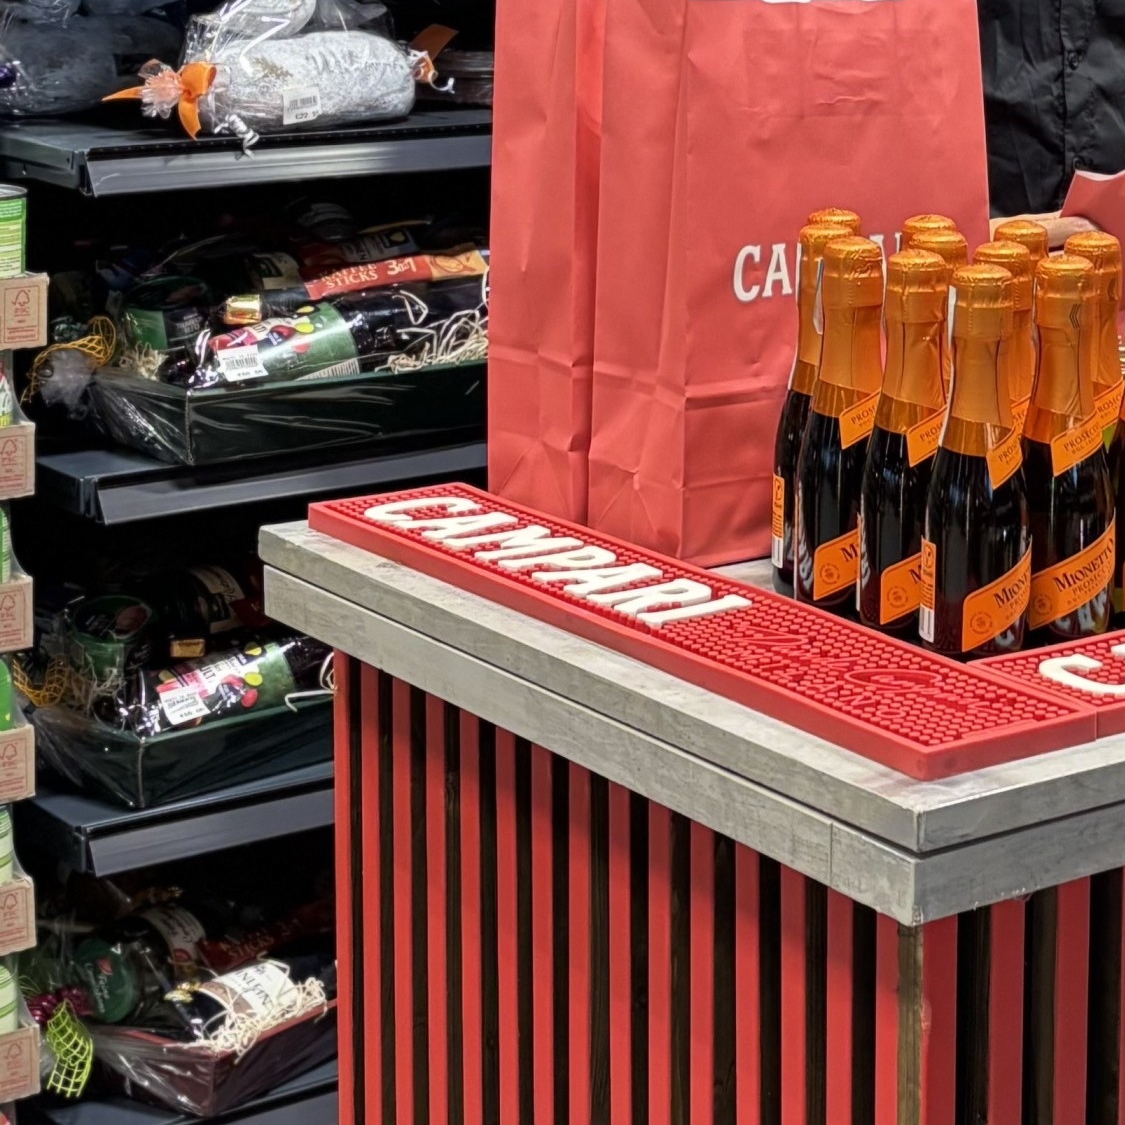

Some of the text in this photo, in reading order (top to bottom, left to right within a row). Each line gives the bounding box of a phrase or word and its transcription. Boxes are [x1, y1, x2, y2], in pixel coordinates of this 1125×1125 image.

[325, 269, 379, 289] STICKS
[363, 496, 752, 627] CAMPARI
[1053, 537, 1115, 593] MIONETTO
